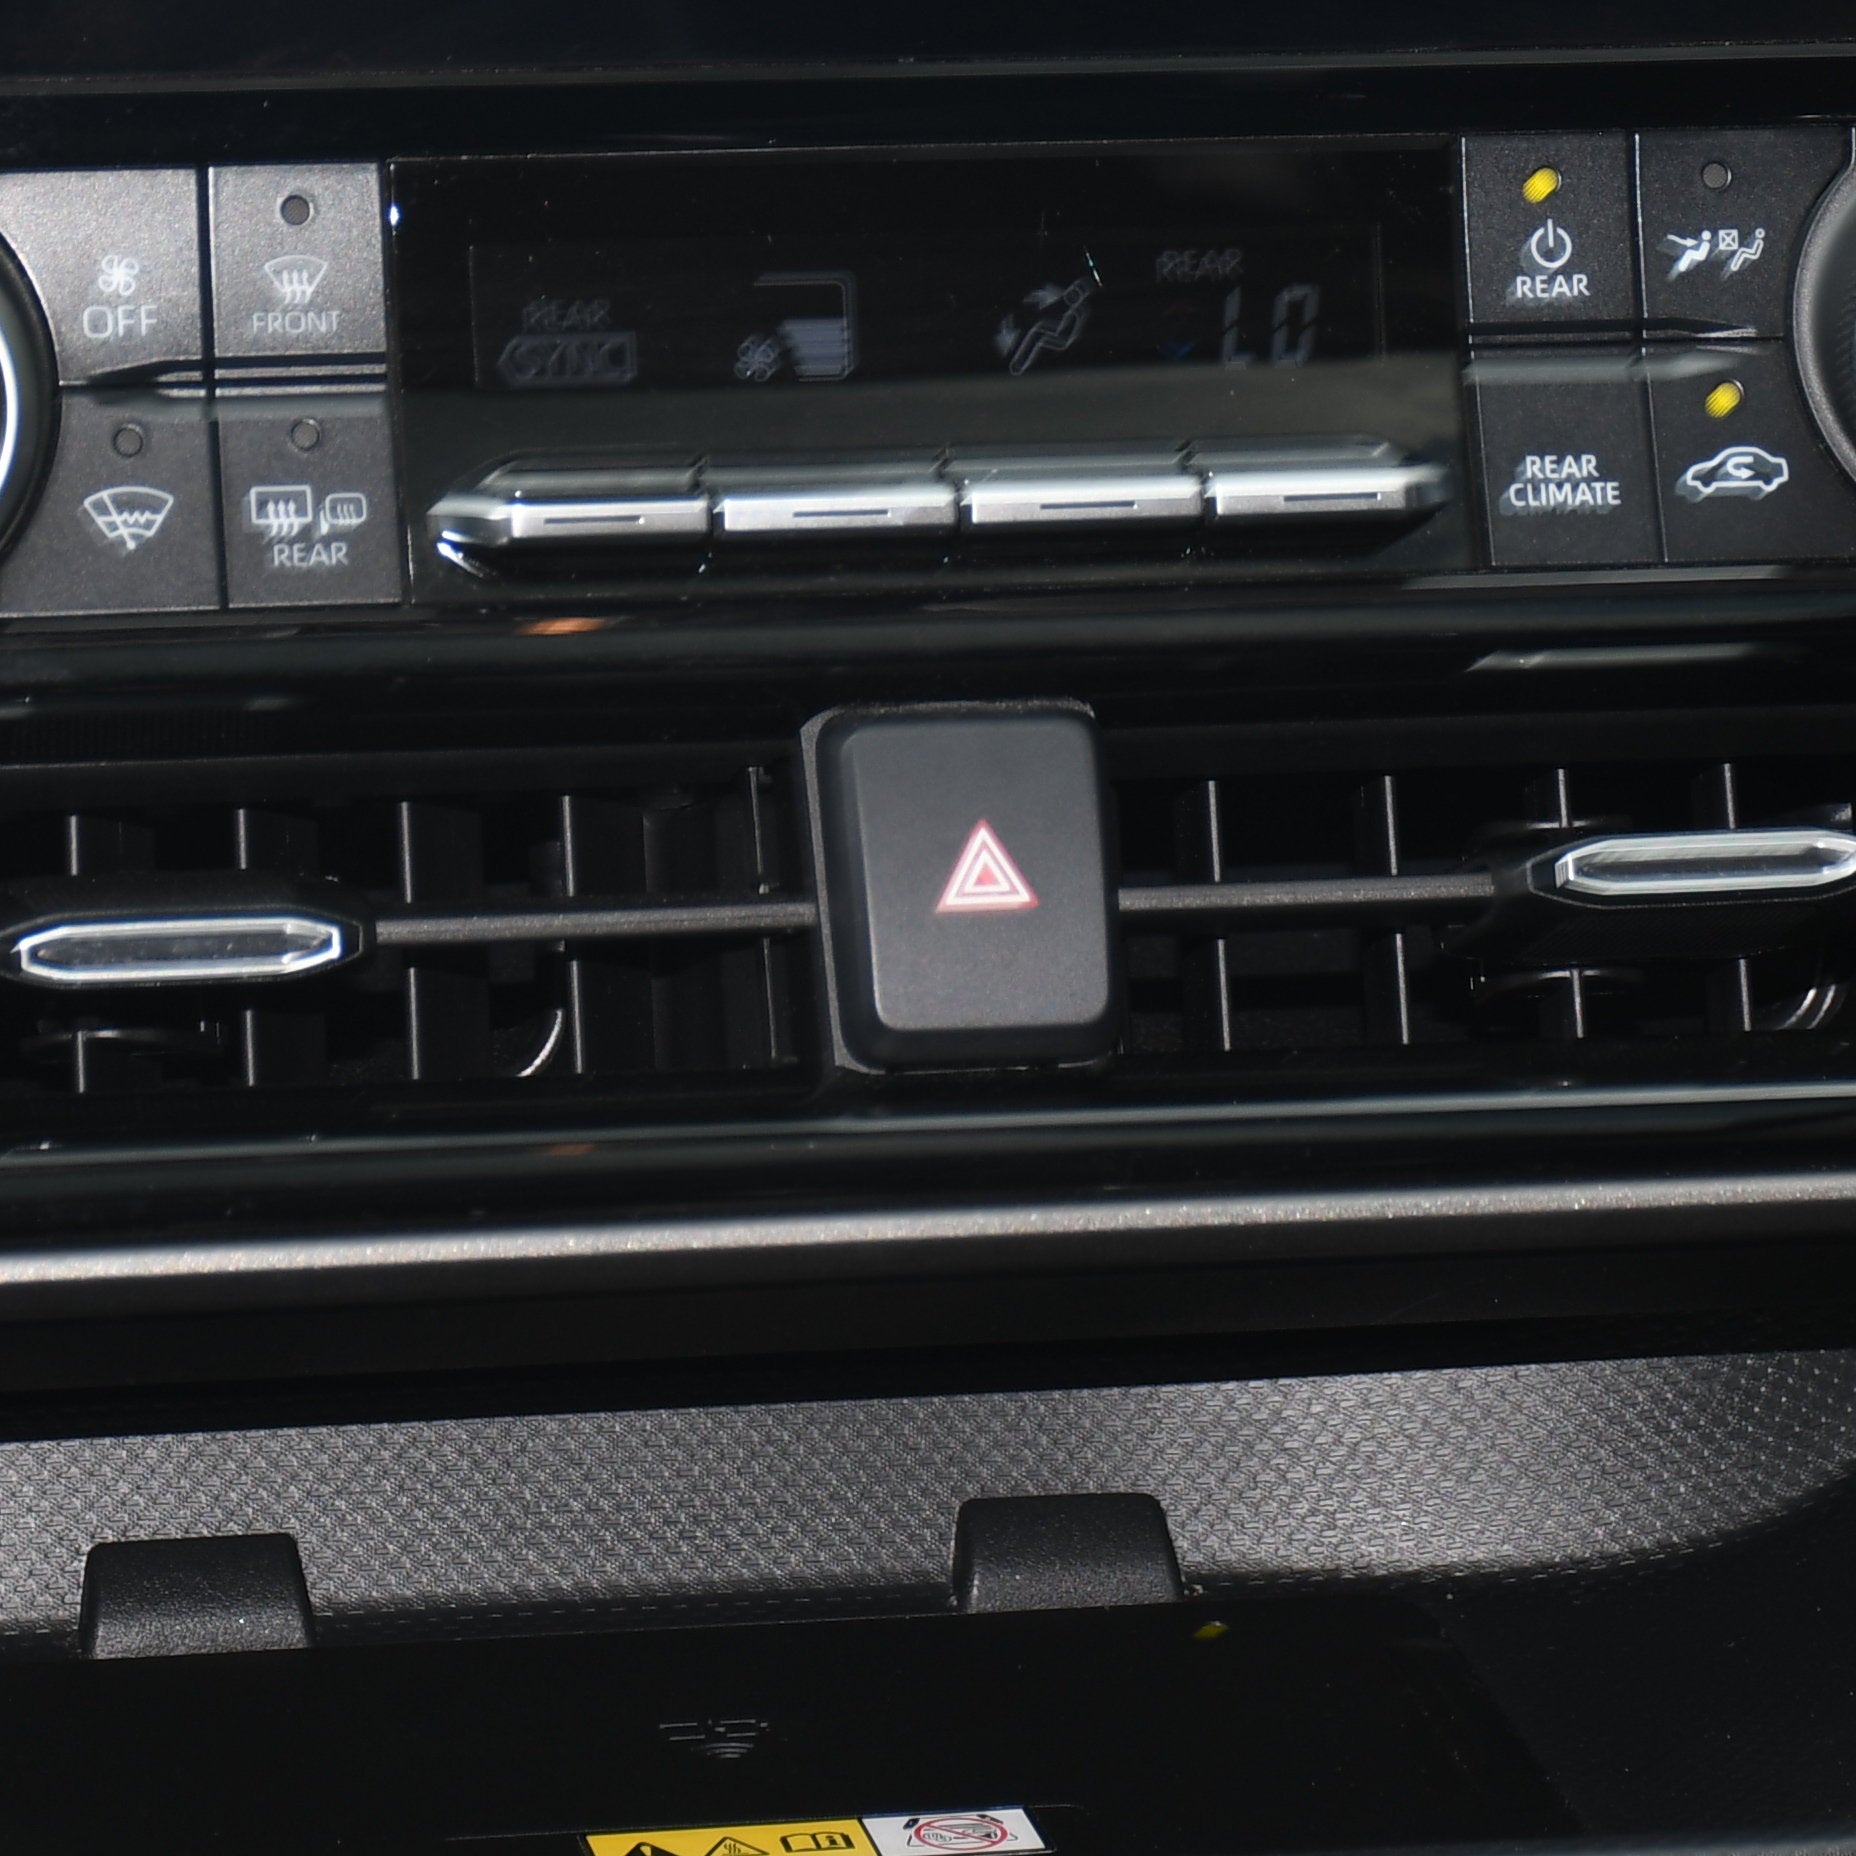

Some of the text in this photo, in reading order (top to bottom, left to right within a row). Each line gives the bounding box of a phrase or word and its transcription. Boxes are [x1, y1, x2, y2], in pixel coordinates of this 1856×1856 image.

[1154, 248, 1244, 284] REAR
[1515, 273, 1591, 299] REAR
[81, 304, 159, 339] OFF
[251, 310, 341, 335] FRONT
[1524, 453, 1601, 480] REAR
[1508, 481, 1622, 508] CLIMATE
[272, 541, 350, 567] REAR
